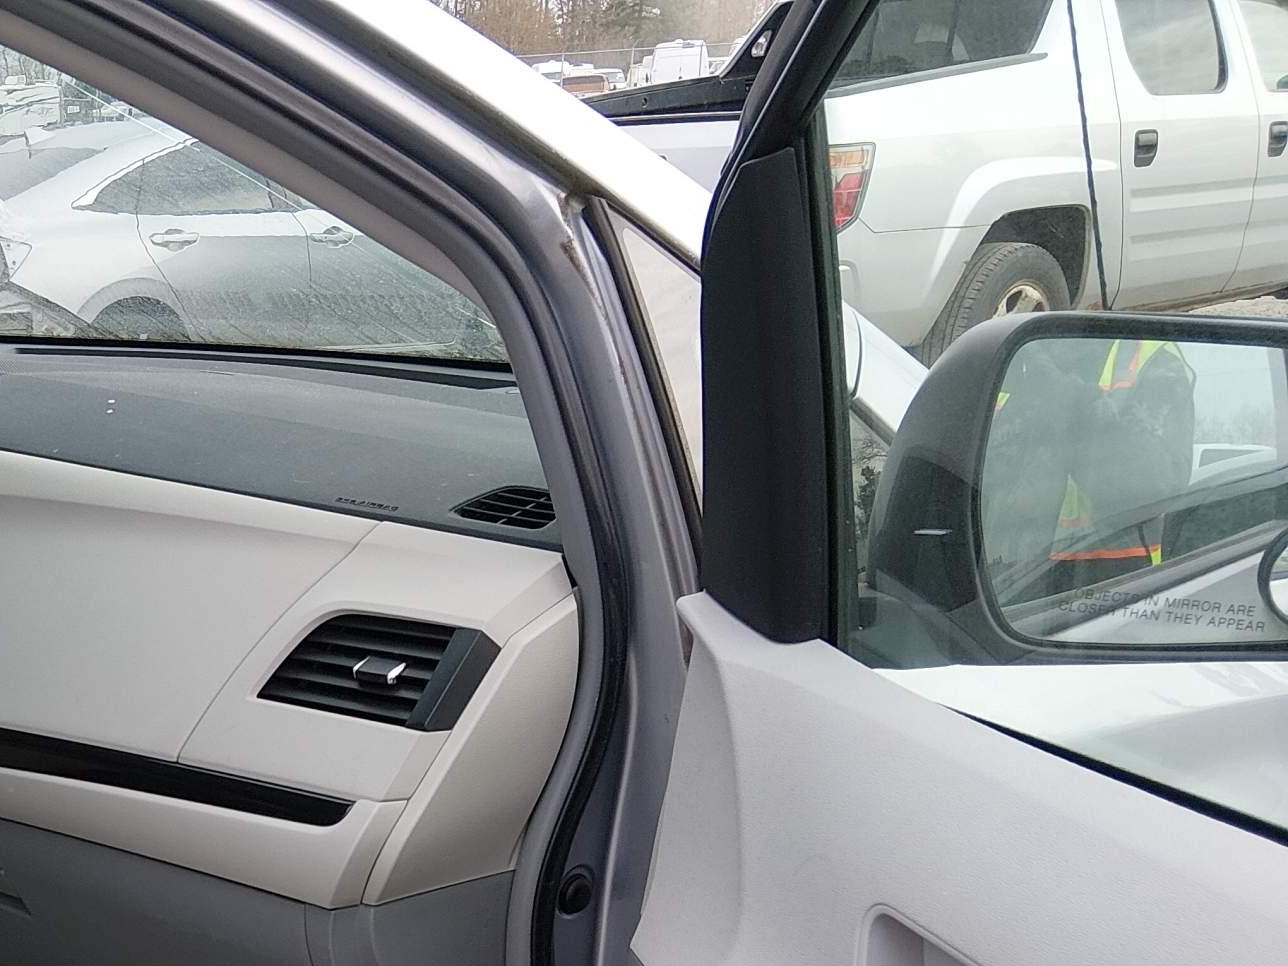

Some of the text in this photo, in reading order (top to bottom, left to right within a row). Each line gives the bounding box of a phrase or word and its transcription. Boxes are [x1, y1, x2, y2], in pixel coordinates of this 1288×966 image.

[1075, 588, 1257, 617] OBJECTS IN MIRROR ARE
[1122, 607, 1160, 622] THAN
[1166, 611, 1204, 626] THEY
[1207, 616, 1266, 633] APPEAR
